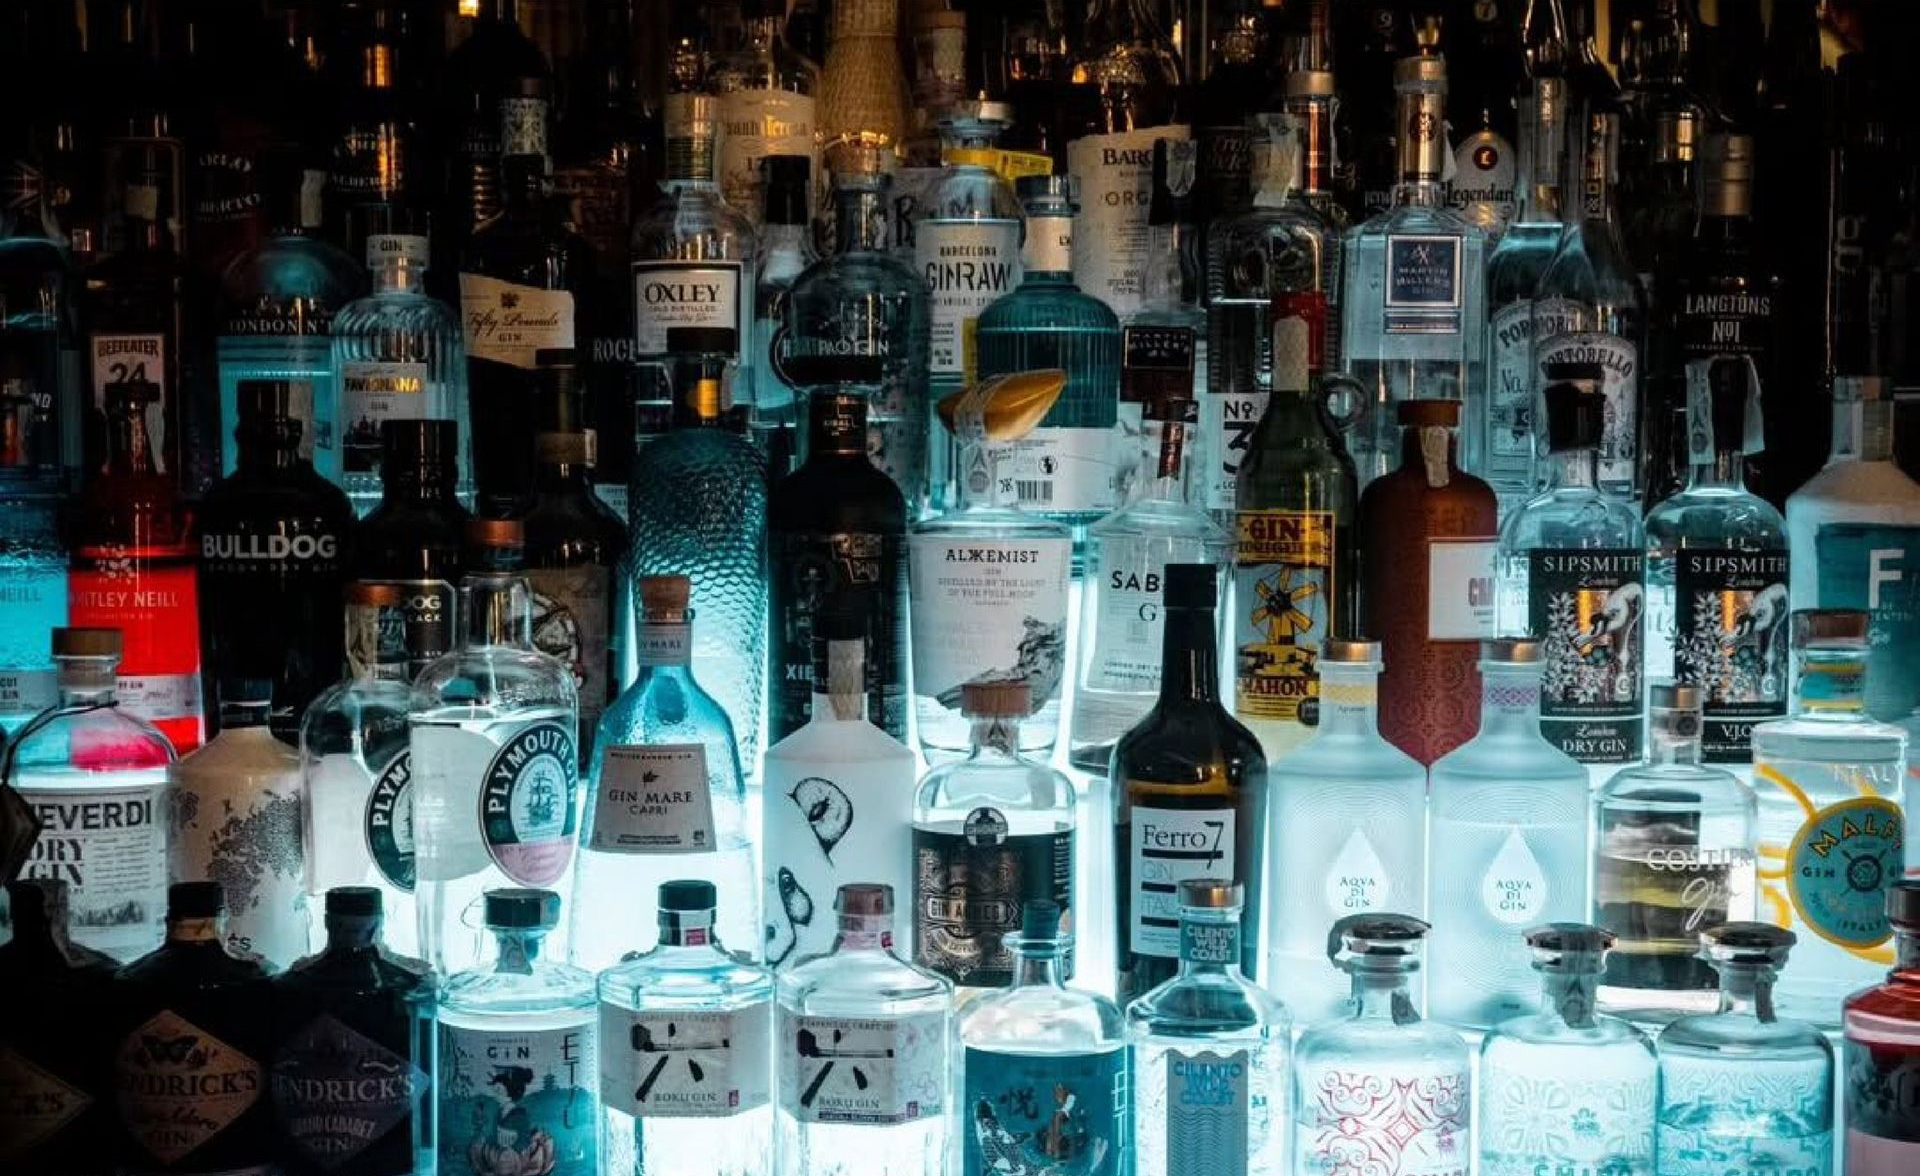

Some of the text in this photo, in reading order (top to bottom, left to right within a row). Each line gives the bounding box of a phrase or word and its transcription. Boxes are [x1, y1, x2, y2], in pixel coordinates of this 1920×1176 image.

[939, 245, 997, 257] BARCELONA
[645, 283, 720, 303] OXLEY
[1685, 293, 1771, 316] LANGTONS
[227, 319, 298, 333] LONDON
[499, 333, 522, 342] GIN
[98, 339, 159, 357] BEEFEATER
[110, 363, 146, 384] 24
[1249, 519, 1300, 542] GIN
[202, 534, 338, 560] BULLDOG
[1544, 556, 1642, 572] SIPSMITH
[1691, 556, 1787, 573] SIPSMITH
[134, 591, 178, 608] NEILL
[1561, 739, 1628, 753] DRY GIN
[488, 730, 569, 813] PLYMOUTH
[609, 789, 694, 803] GIN MARE
[630, 805, 668, 815] CAPRI
[1802, 866, 1835, 878] GIN
[1339, 877, 1375, 888] AQVA
[1496, 880, 1532, 892] AQVA
[1351, 888, 1364, 897] DI
[1507, 892, 1521, 901] DI
[1344, 898, 1370, 908] GIN
[1500, 901, 1527, 911] GIN
[487, 1047, 530, 1059] GIN
[1173, 1061, 1242, 1076] CILENTO
